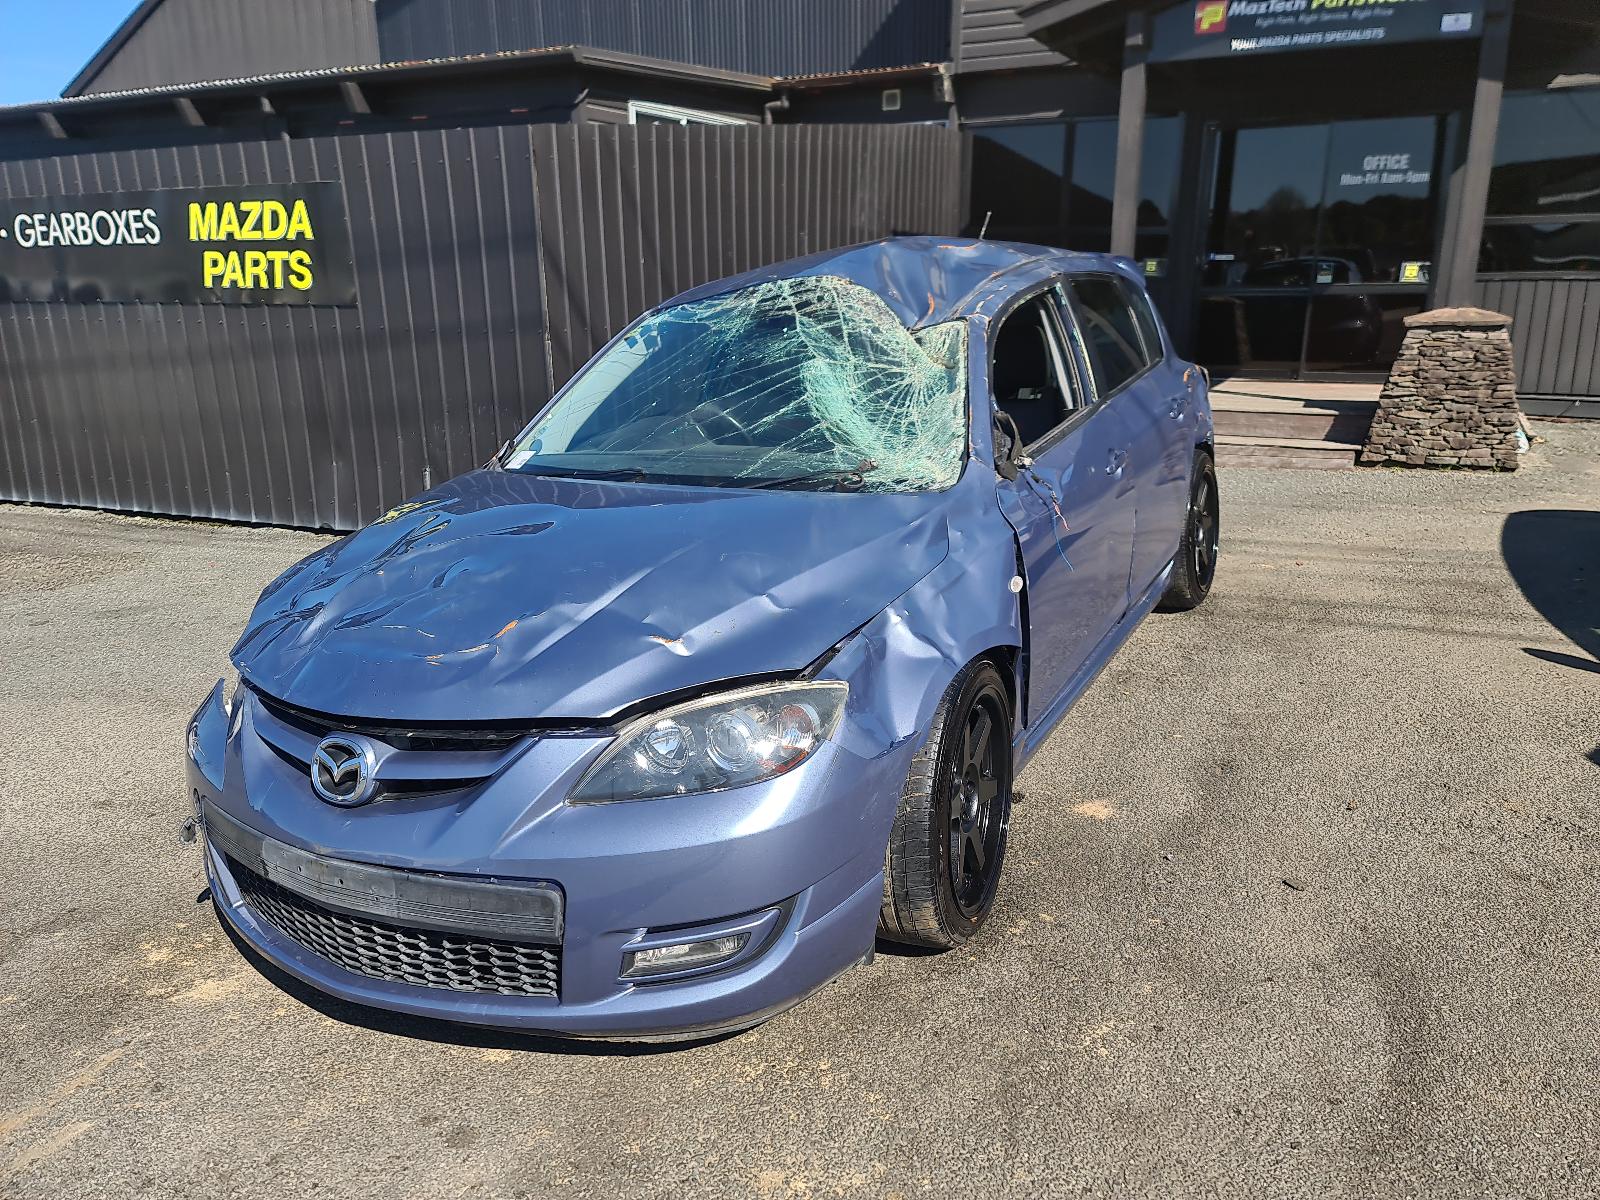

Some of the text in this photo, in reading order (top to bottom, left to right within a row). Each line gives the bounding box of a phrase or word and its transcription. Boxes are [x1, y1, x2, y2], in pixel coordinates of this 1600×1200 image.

[1291, 31, 1324, 45] PARTS
[1324, 26, 1386, 43] SPECIALISTS
[1363, 154, 1410, 171] OFFICE
[14, 208, 161, 248] GEARBOXES
[188, 199, 315, 242] MAZDA
[203, 250, 314, 291] PARTS
